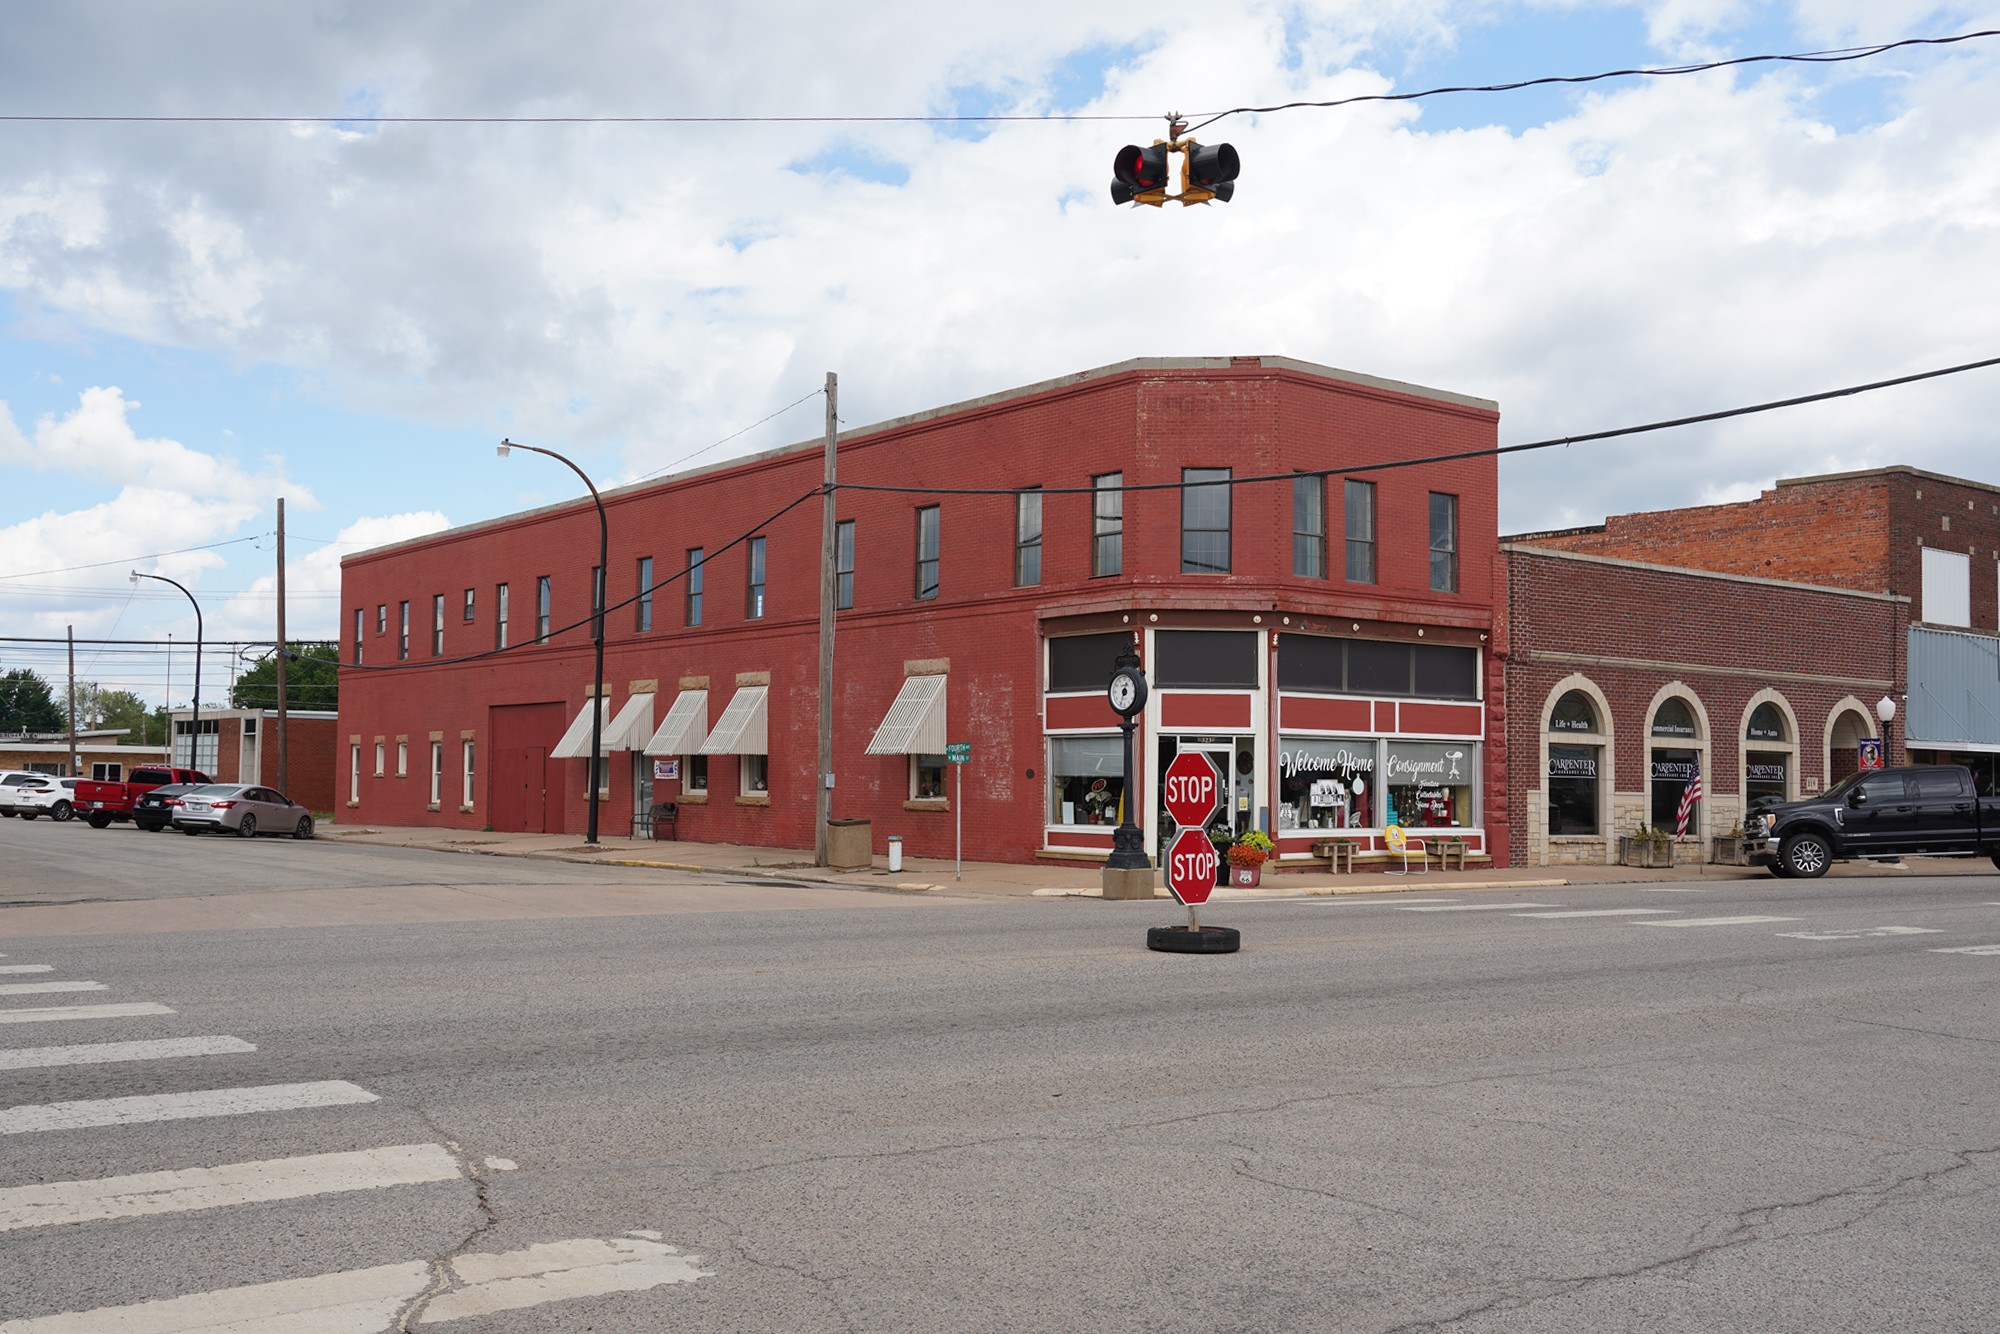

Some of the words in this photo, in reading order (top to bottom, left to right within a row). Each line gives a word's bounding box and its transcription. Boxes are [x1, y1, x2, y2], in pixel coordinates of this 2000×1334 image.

[1555, 719, 1566, 728] Life
[1571, 720, 1588, 729] Health
[1674, 725, 1694, 733] Insurance
[1750, 728, 1763, 736] Home
[1766, 729, 1778, 737] Auto
[951, 754, 965, 762] MAIN
[1279, 749, 1338, 779] Welcome
[1337, 749, 1374, 780] Home
[1386, 754, 1445, 782] Consignment
[1548, 758, 1596, 776] CARPENTER
[1745, 764, 1784, 780] CARPENTER
[1168, 775, 1213, 804] STOP
[1174, 852, 1214, 882] STOP
